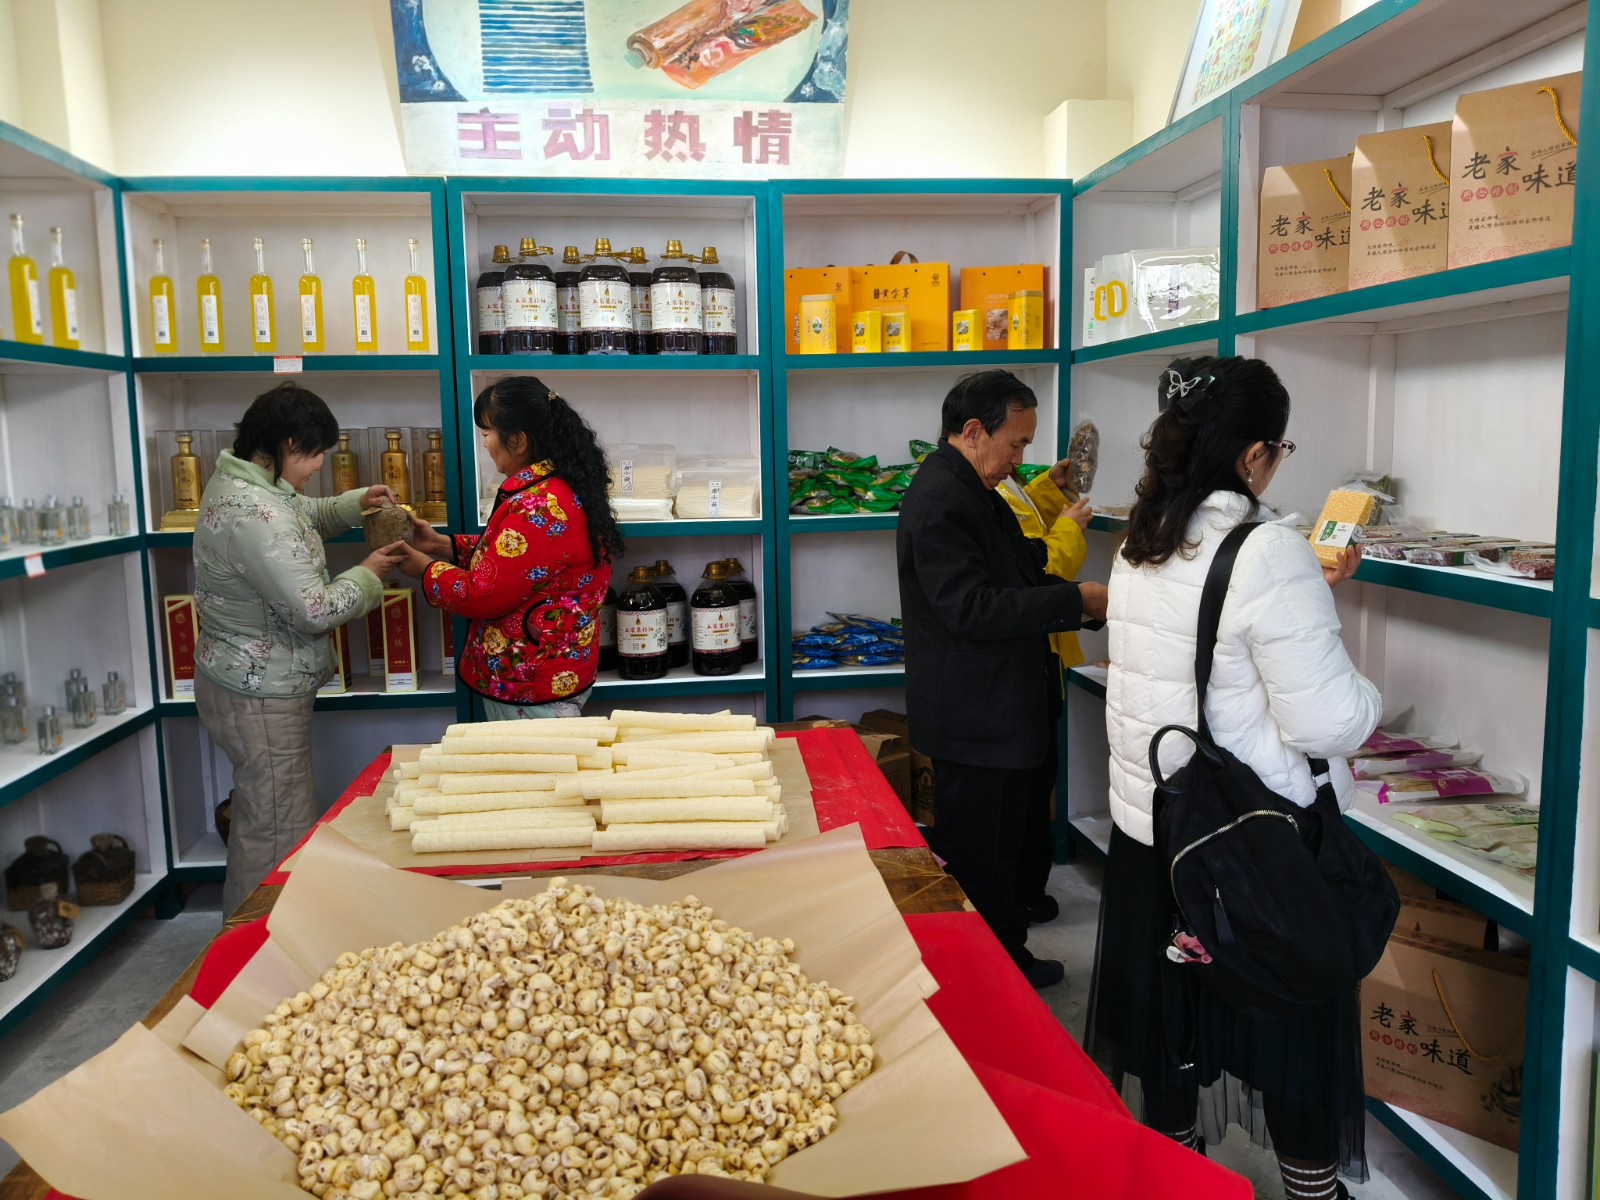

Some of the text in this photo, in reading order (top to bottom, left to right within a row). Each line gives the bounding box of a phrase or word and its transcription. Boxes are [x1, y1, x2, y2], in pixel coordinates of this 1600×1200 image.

[457, 107, 793, 165] 主动热情
[1461, 145, 1577, 194] 老家味道
[1370, 1002, 1473, 1076] 老家味道
